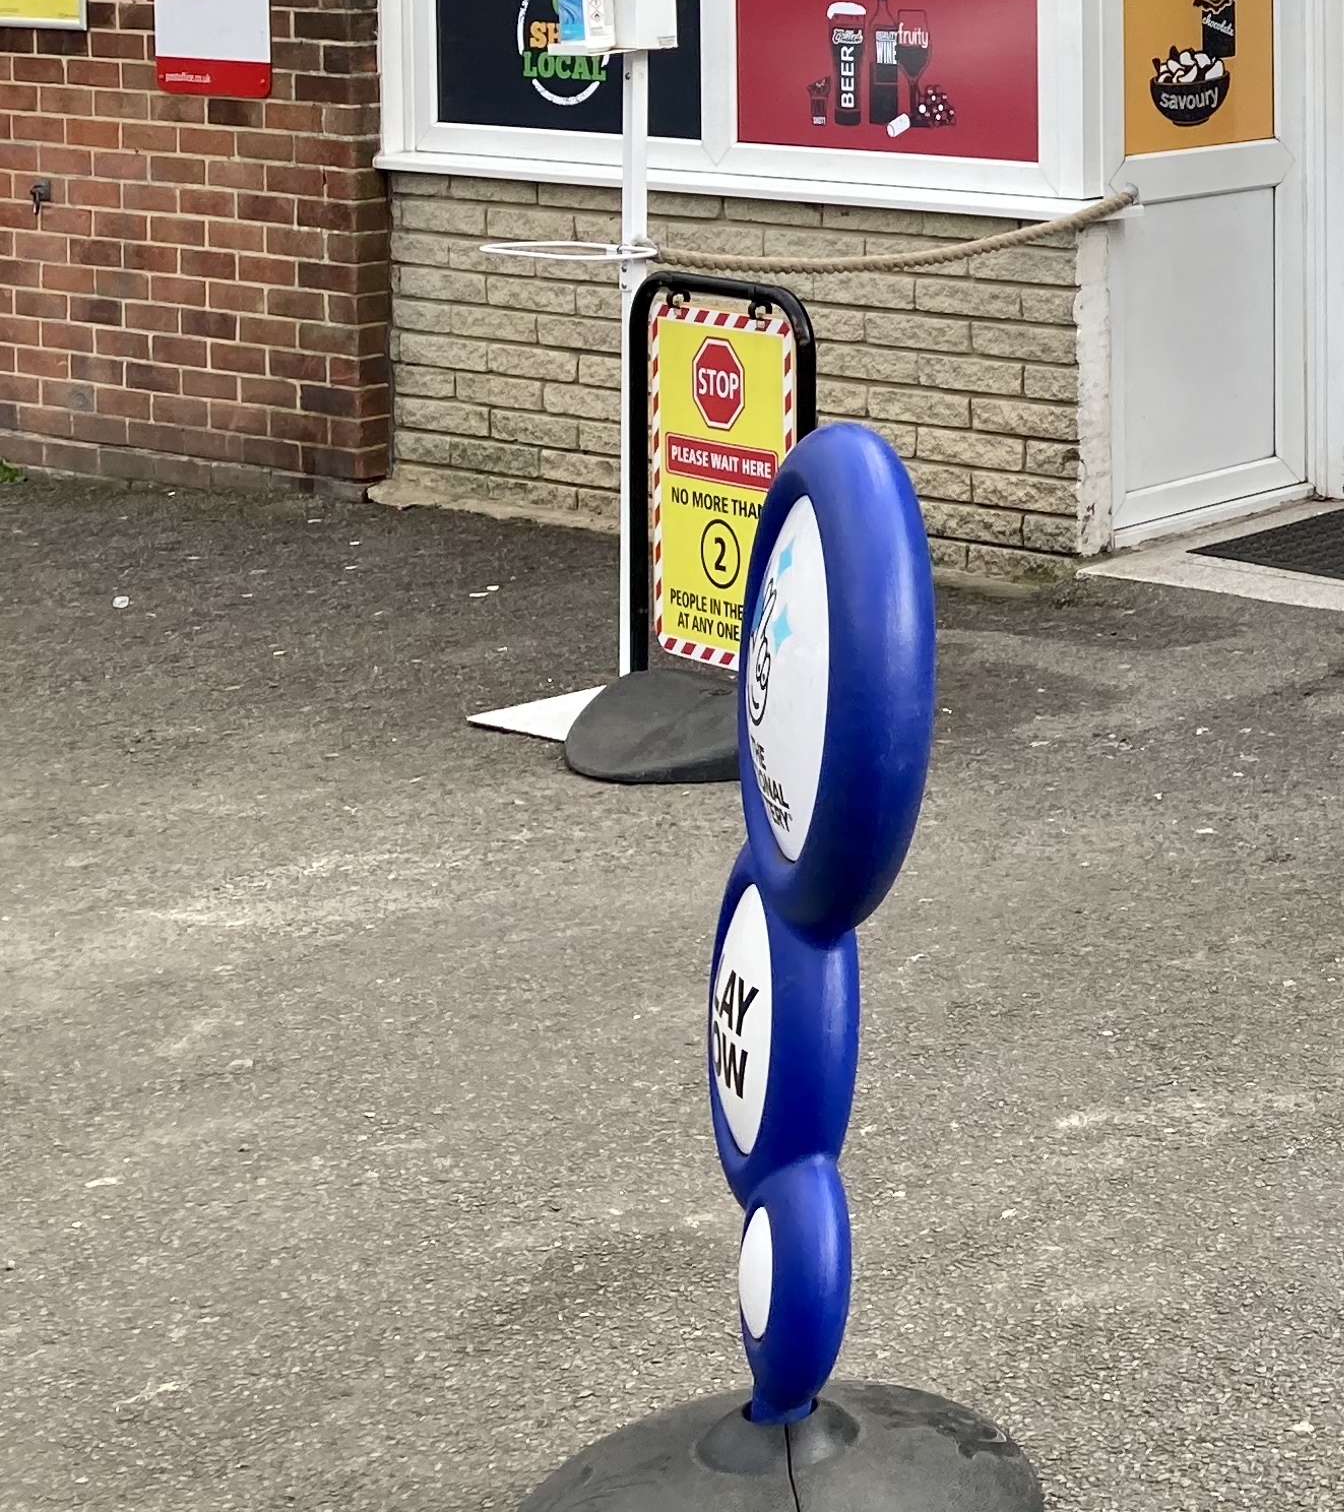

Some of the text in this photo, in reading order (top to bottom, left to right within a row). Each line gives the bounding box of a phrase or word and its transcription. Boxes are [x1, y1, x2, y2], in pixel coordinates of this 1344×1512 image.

[897, 22, 929, 48] fruity
[1202, 13, 1235, 37] chocolate
[522, 51, 607, 81] LOCAL
[876, 41, 897, 64] WINE
[841, 46, 855, 108] BEER
[1159, 86, 1219, 110] savoury
[698, 367, 740, 400] STOP
[671, 444, 772, 479] PLEASE WAIT HERE
[671, 486, 729, 514] NO MORE
[714, 537, 727, 573] 2
[670, 588, 744, 621] PEOPLE IN THE
[677, 612, 740, 642] AT ANY ONE
